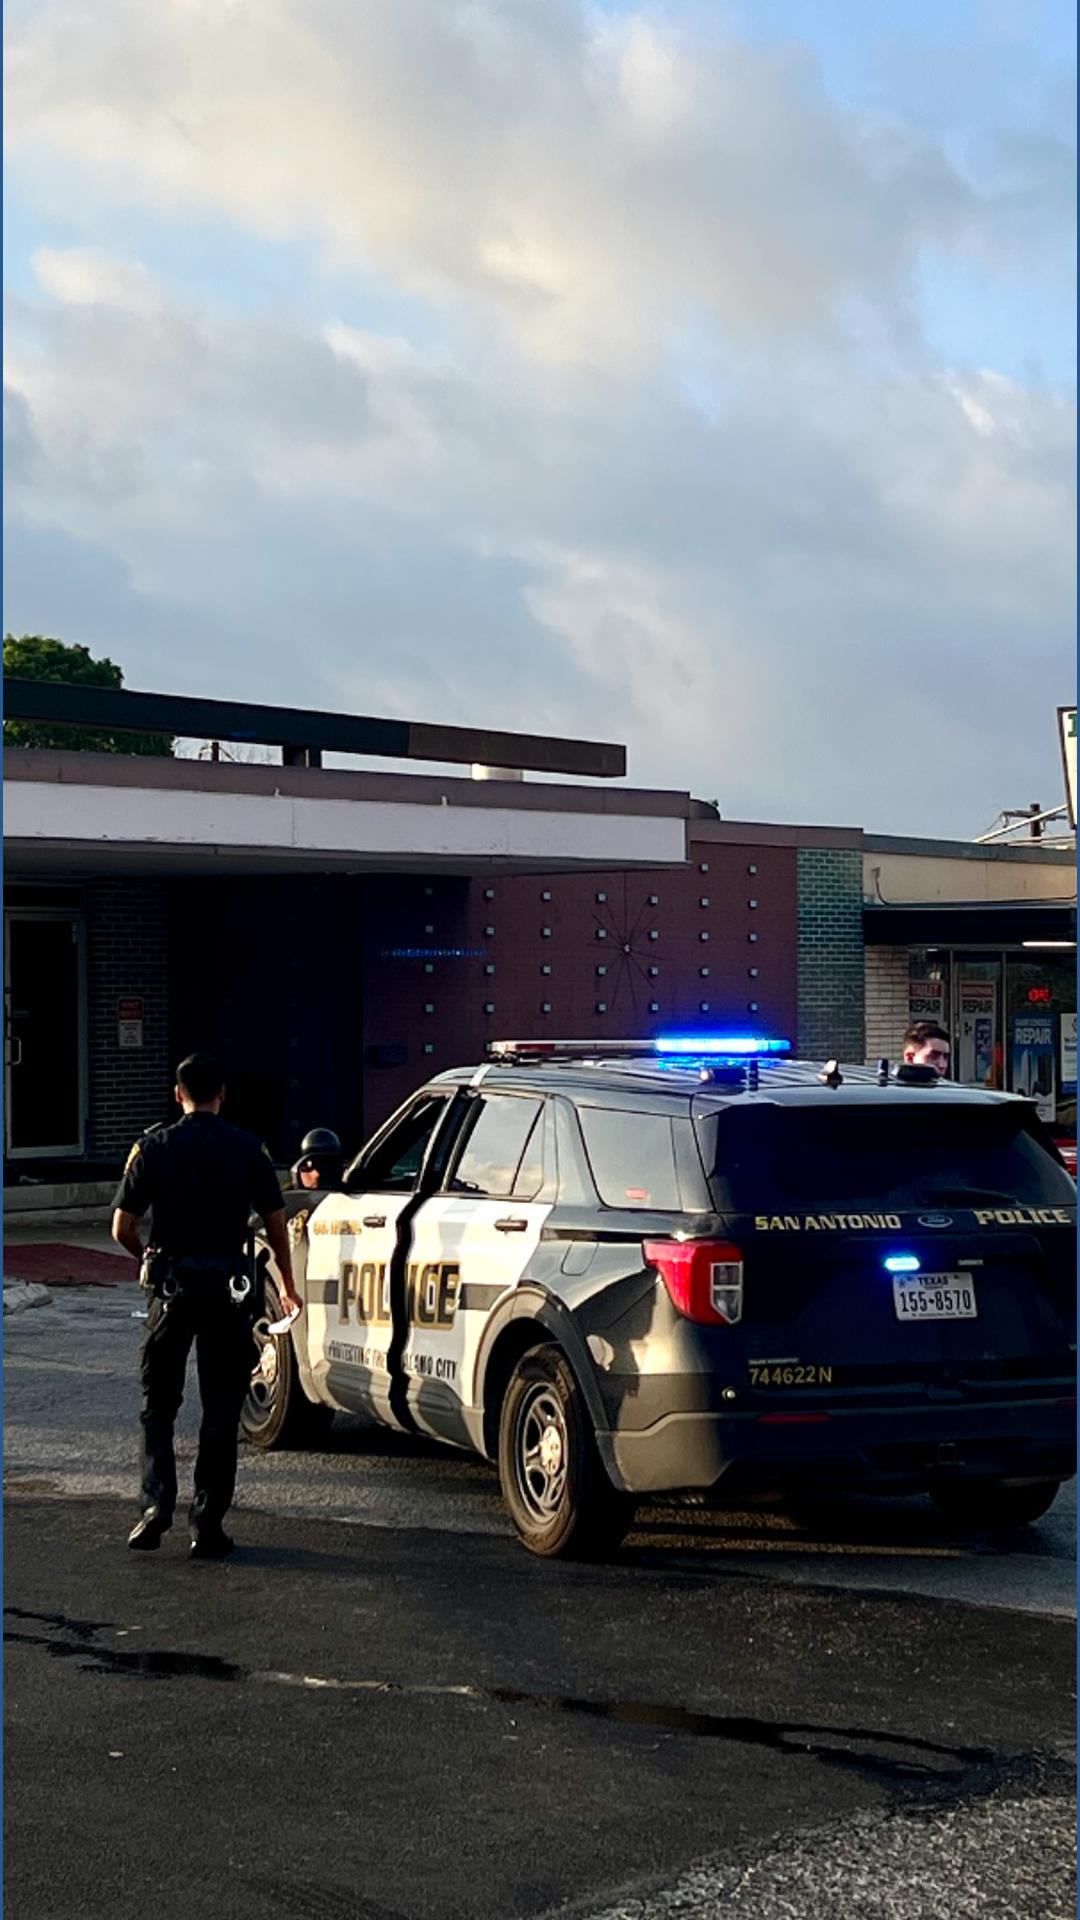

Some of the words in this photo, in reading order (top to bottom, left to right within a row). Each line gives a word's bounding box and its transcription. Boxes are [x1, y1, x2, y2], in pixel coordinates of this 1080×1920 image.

[1015, 1027, 1052, 1045] REPAIR
[755, 1216, 801, 1231] SAN
[805, 1214, 901, 1230] ANTONIO
[972, 1208, 1072, 1225] POLICE
[918, 1277, 949, 1286] TEXAS
[339, 1261, 460, 1330] POLICE
[436, 1357, 457, 1379] CITY
[748, 1365, 832, 1386] 744622N
